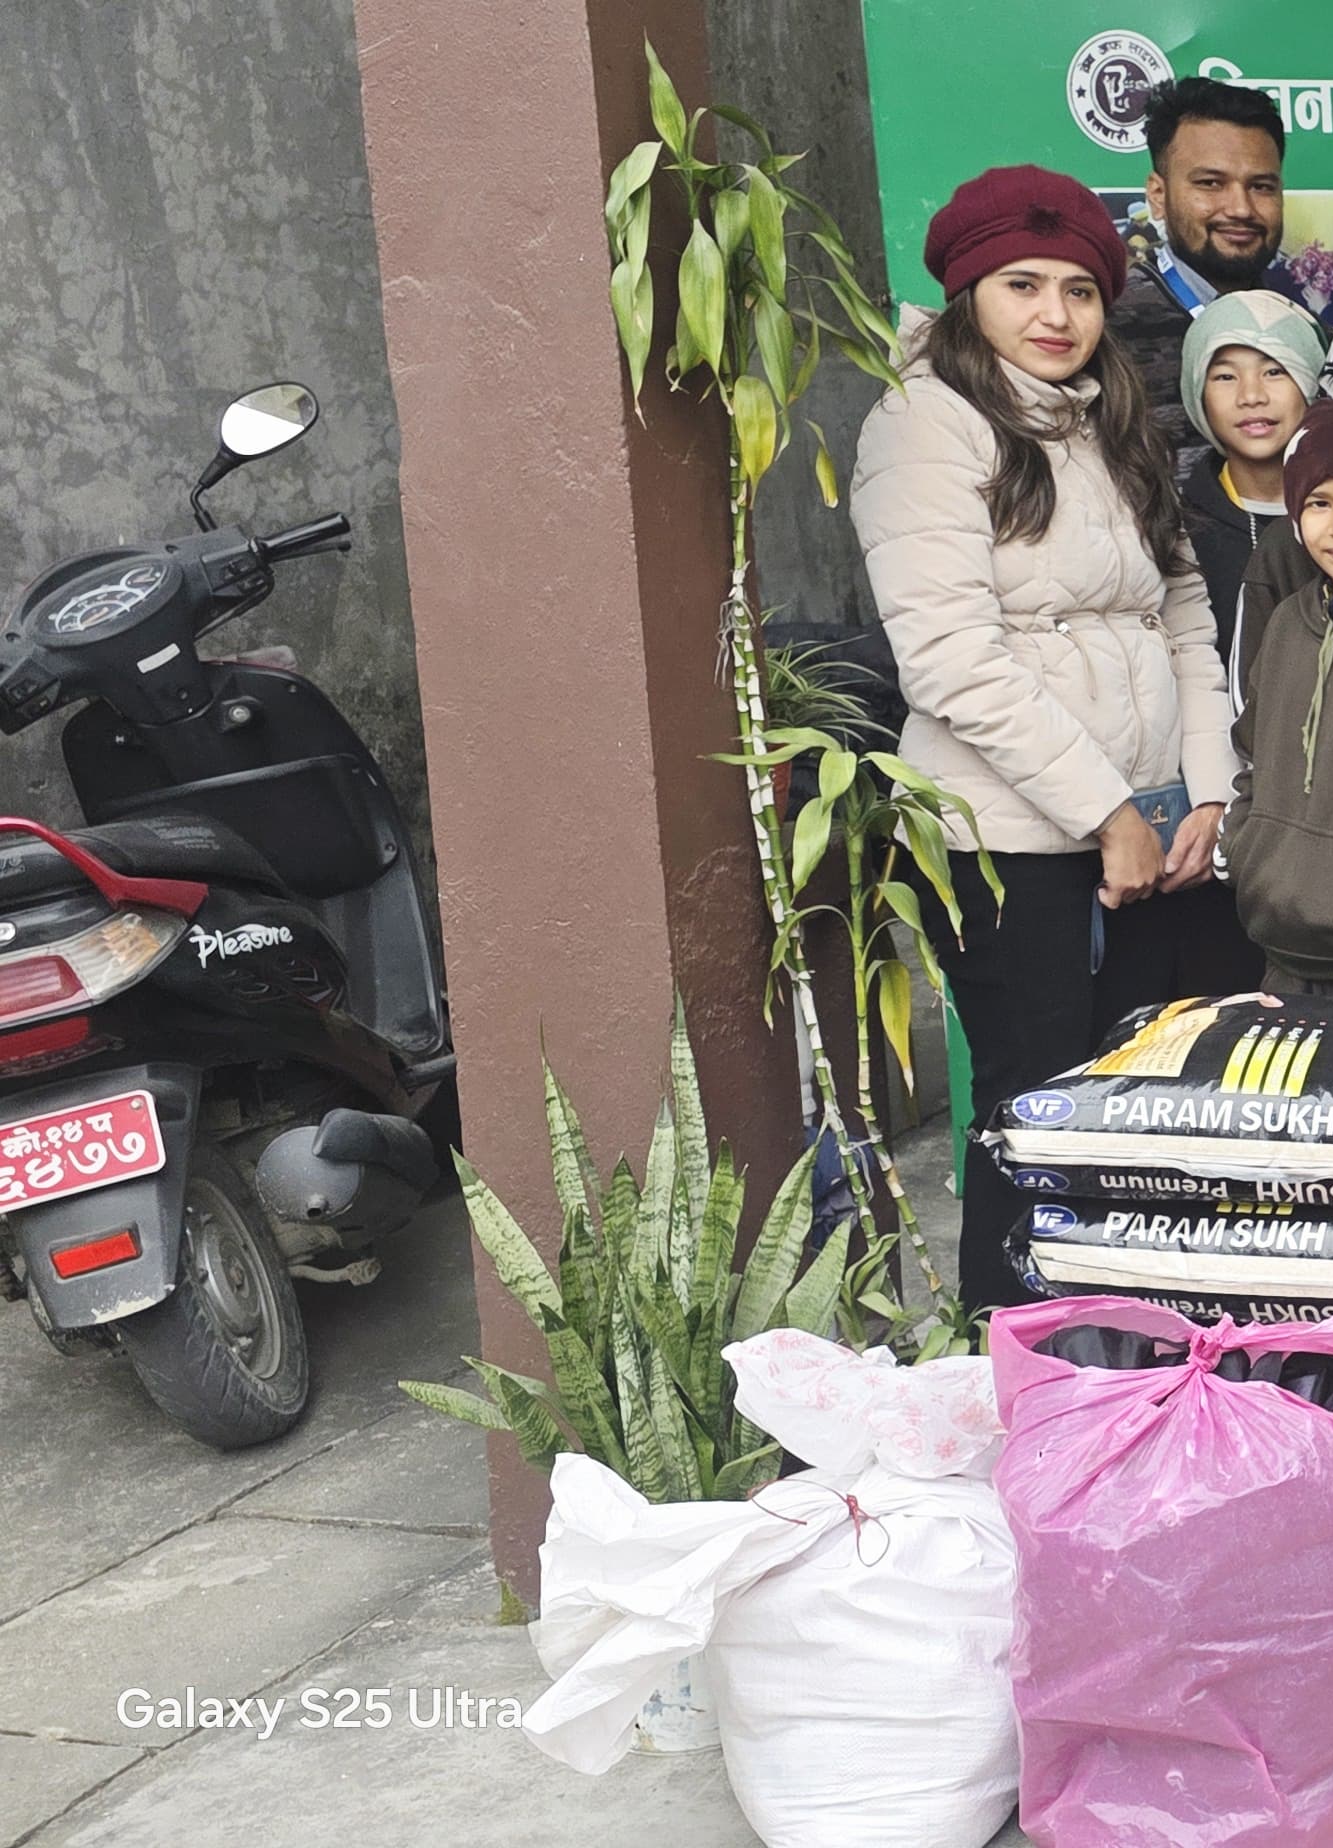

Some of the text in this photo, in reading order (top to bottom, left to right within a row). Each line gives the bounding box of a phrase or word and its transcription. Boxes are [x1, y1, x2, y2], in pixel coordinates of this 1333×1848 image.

[189, 923, 293, 968] Pleasure
[1028, 1099, 1064, 1116] VF
[1102, 1096, 1232, 1131] PARAM
[1100, 1174, 1228, 1199] Premium
[1033, 1211, 1065, 1229] VF
[1102, 1211, 1228, 1247] PARAM
[1230, 1217, 1328, 1252] SUKH
